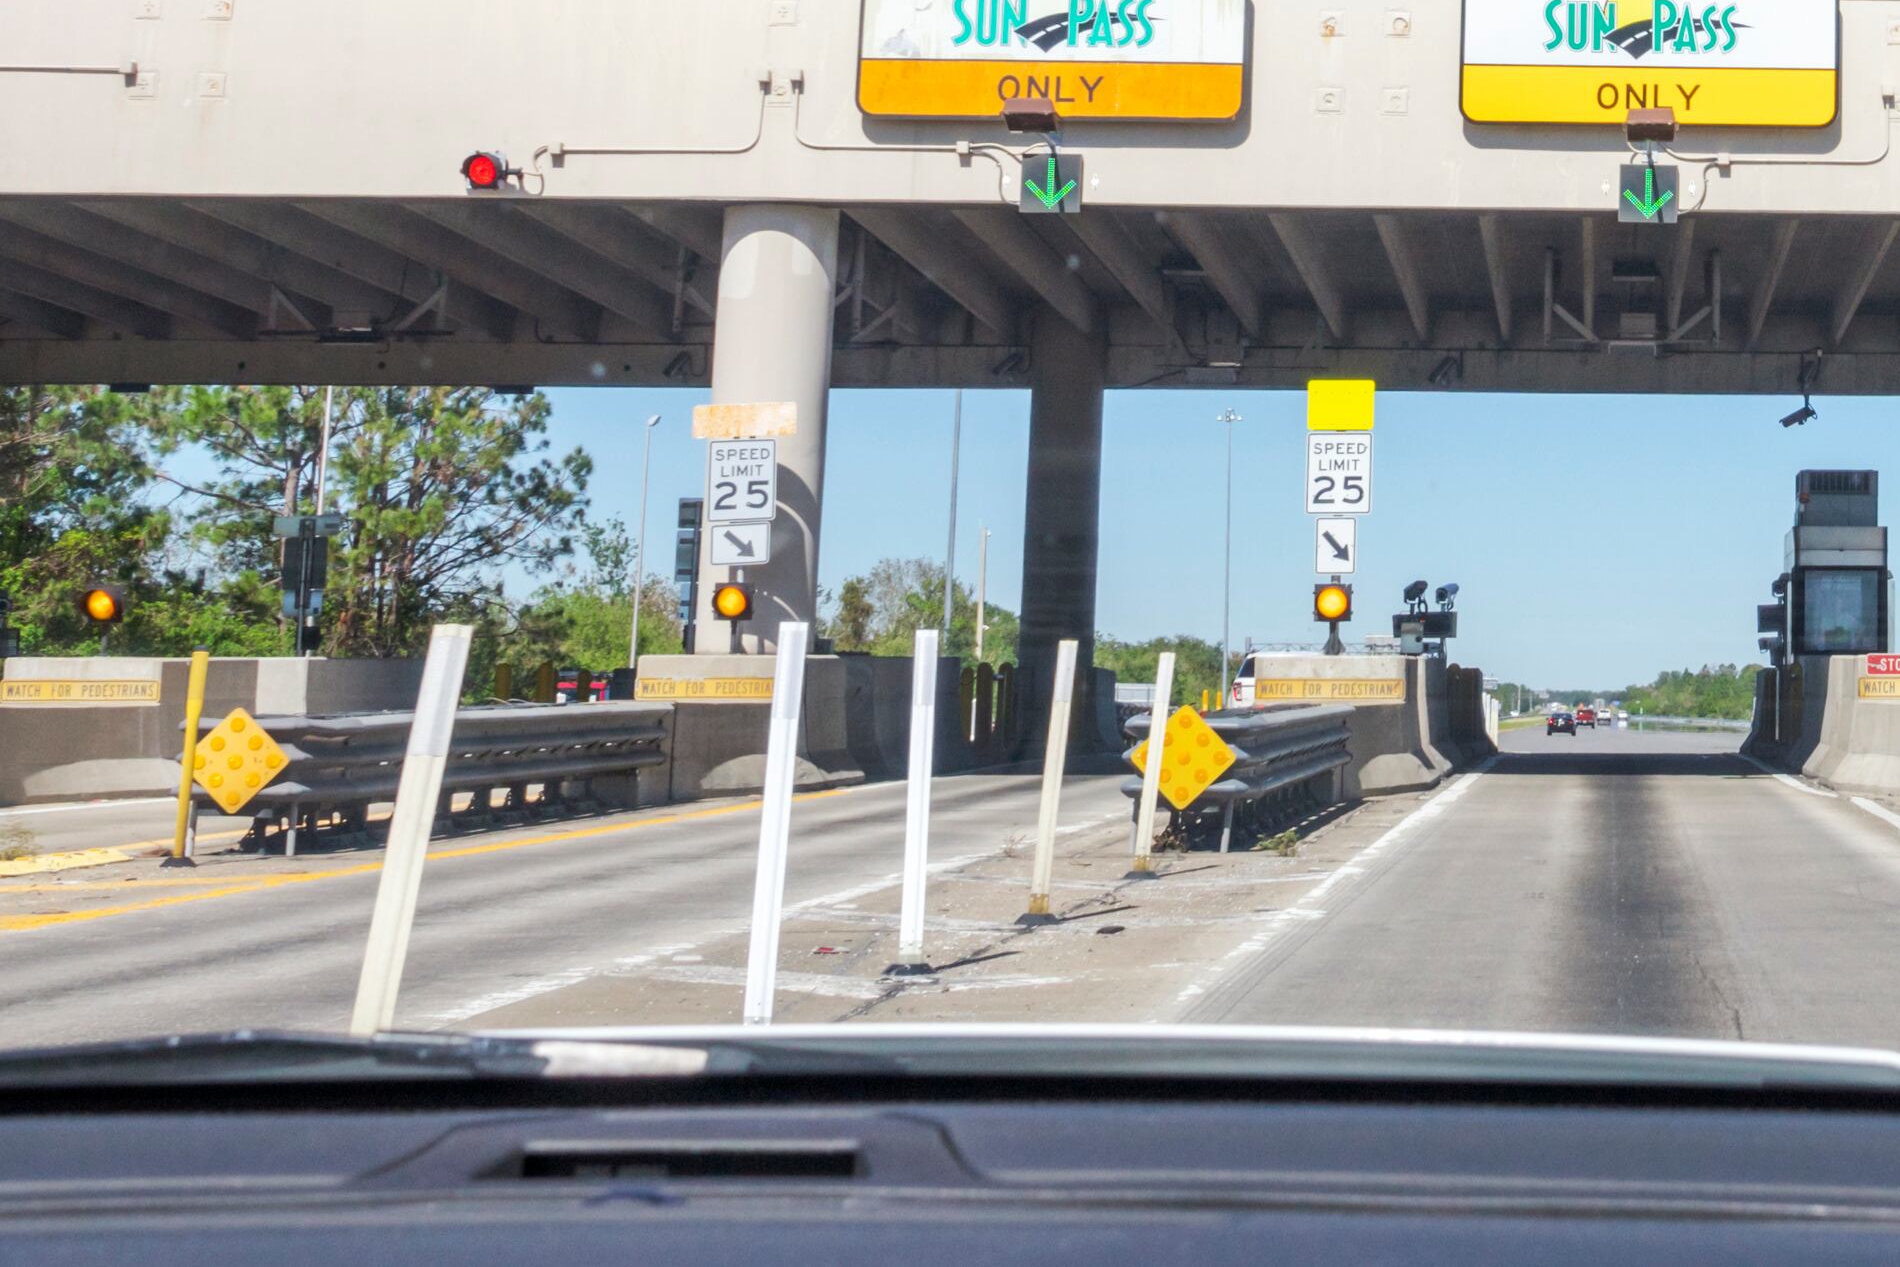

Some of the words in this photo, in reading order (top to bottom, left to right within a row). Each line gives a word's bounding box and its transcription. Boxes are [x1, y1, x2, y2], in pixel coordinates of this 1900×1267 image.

[998, 75, 1104, 103] ONLY
[1597, 83, 1700, 111] ONLY
[715, 448, 770, 461] SPEED
[1313, 442, 1367, 454] SPEED
[720, 464, 763, 477] LIMIT
[1319, 459, 1360, 471] LIMIT
[714, 480, 769, 510] 25
[1313, 476, 1364, 504] 25
[7, 684, 41, 697] WATCH
[51, 684, 71, 697] FOR
[81, 684, 154, 697] PEDESTRIANS
[642, 682, 675, 694] WATCH
[685, 682, 705, 694] FOR
[715, 682, 774, 694] PEDESTRIA
[1261, 683, 1292, 695] WATCH
[1303, 683, 1321, 695] FOR
[1863, 681, 1895, 693] WATCH
